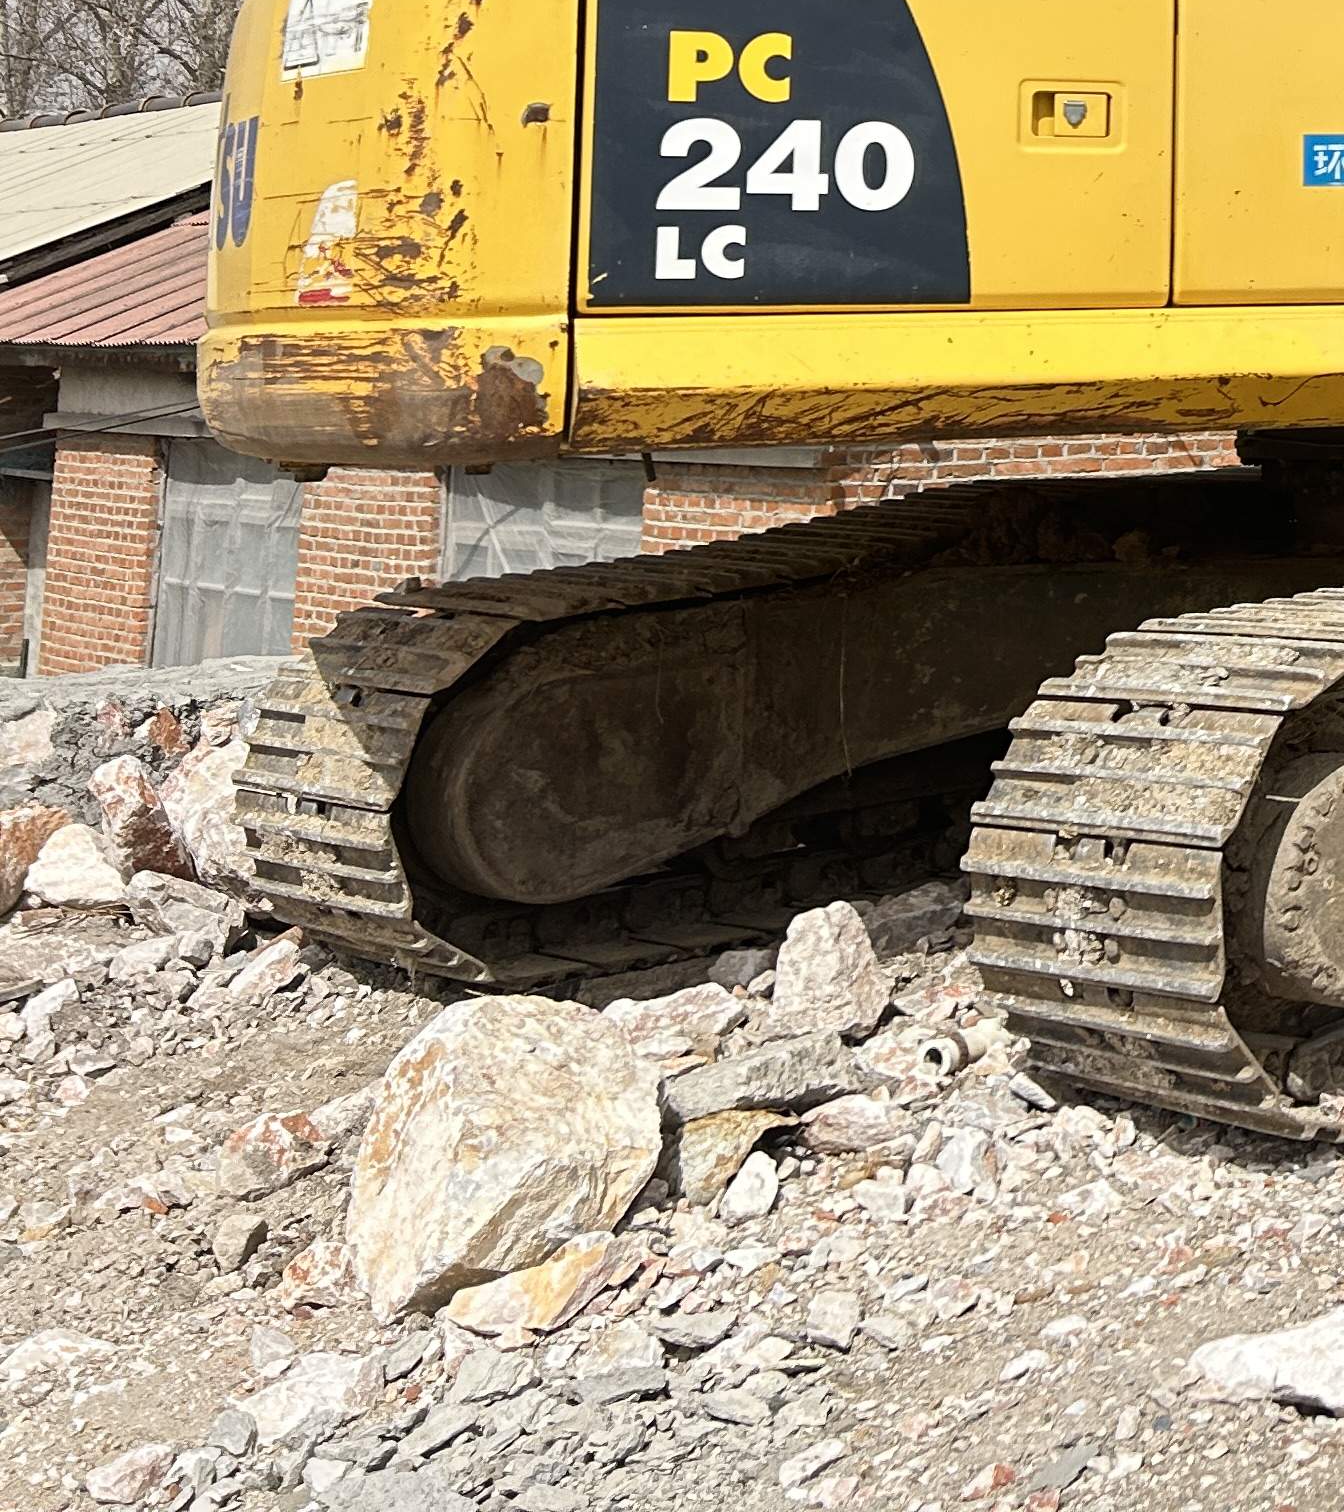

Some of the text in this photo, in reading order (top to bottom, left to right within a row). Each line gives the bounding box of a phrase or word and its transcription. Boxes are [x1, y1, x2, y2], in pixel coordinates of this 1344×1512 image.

[668, 30, 792, 103] PC
[655, 117, 915, 212] 240
[655, 224, 746, 279] LC
